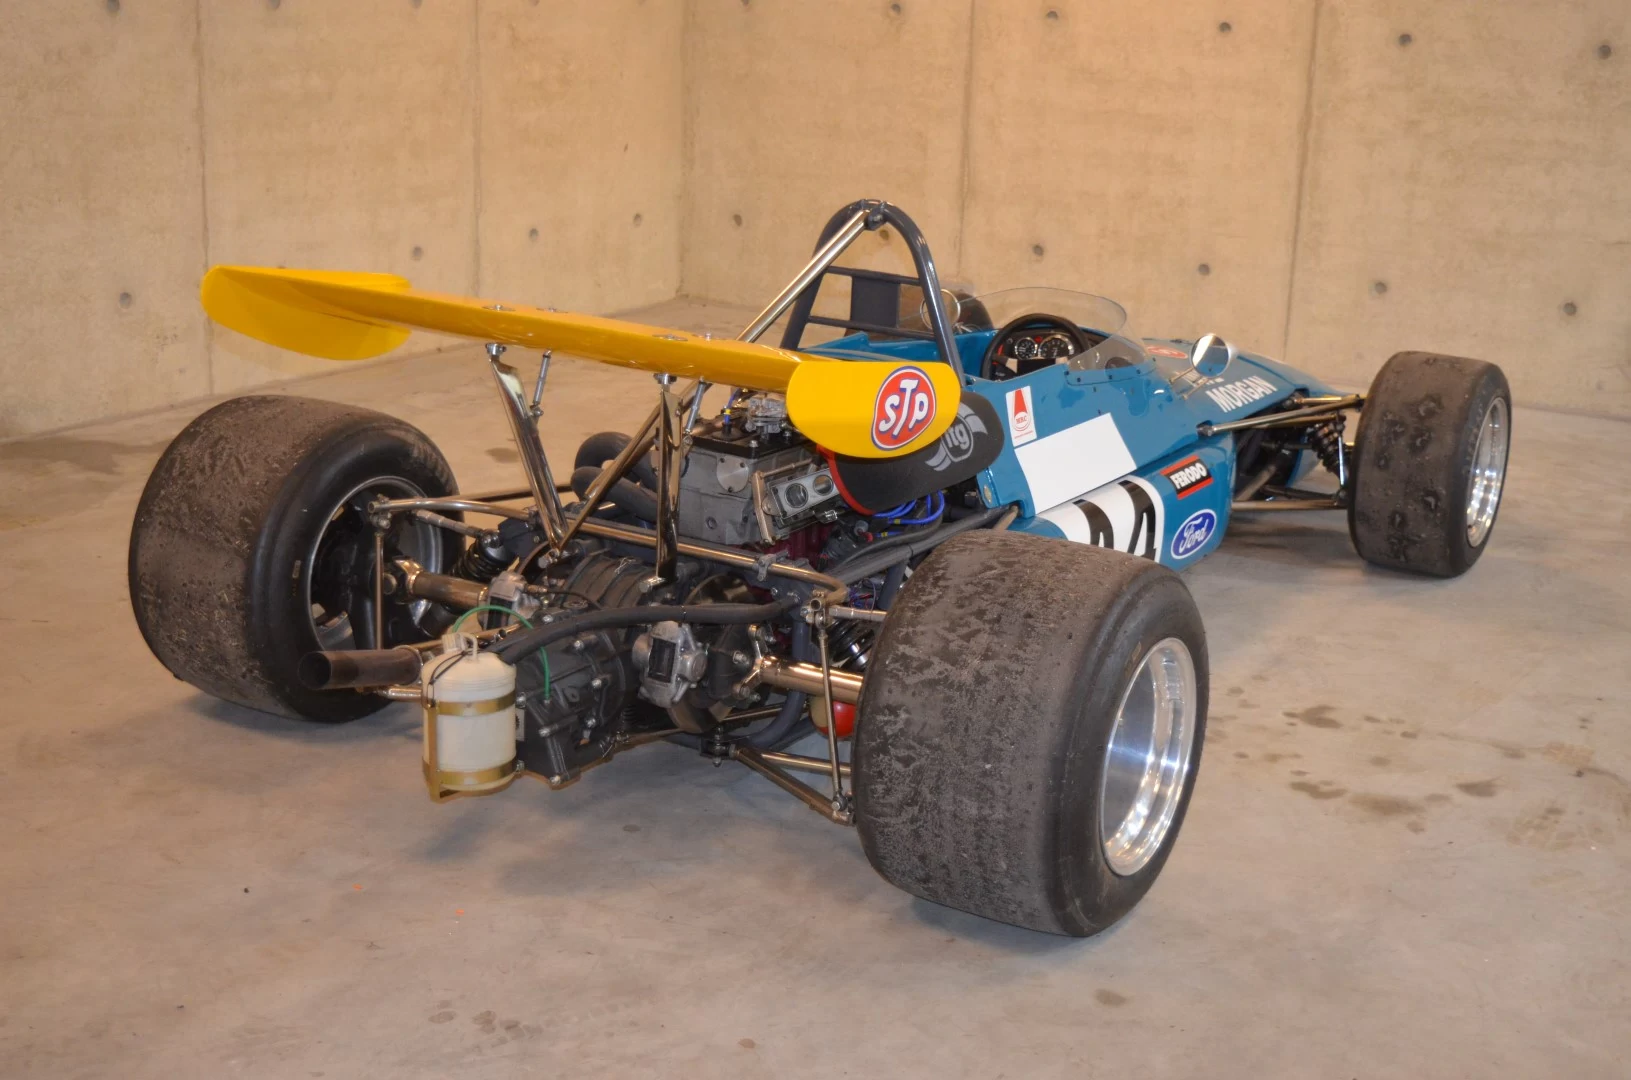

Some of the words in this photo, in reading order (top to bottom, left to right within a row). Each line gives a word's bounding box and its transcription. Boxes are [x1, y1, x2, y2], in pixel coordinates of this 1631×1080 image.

[878, 379, 929, 438] STP
[1205, 375, 1278, 413] MORGAN
[1169, 461, 1208, 490] FERODO
[1178, 516, 1209, 554] Ford
